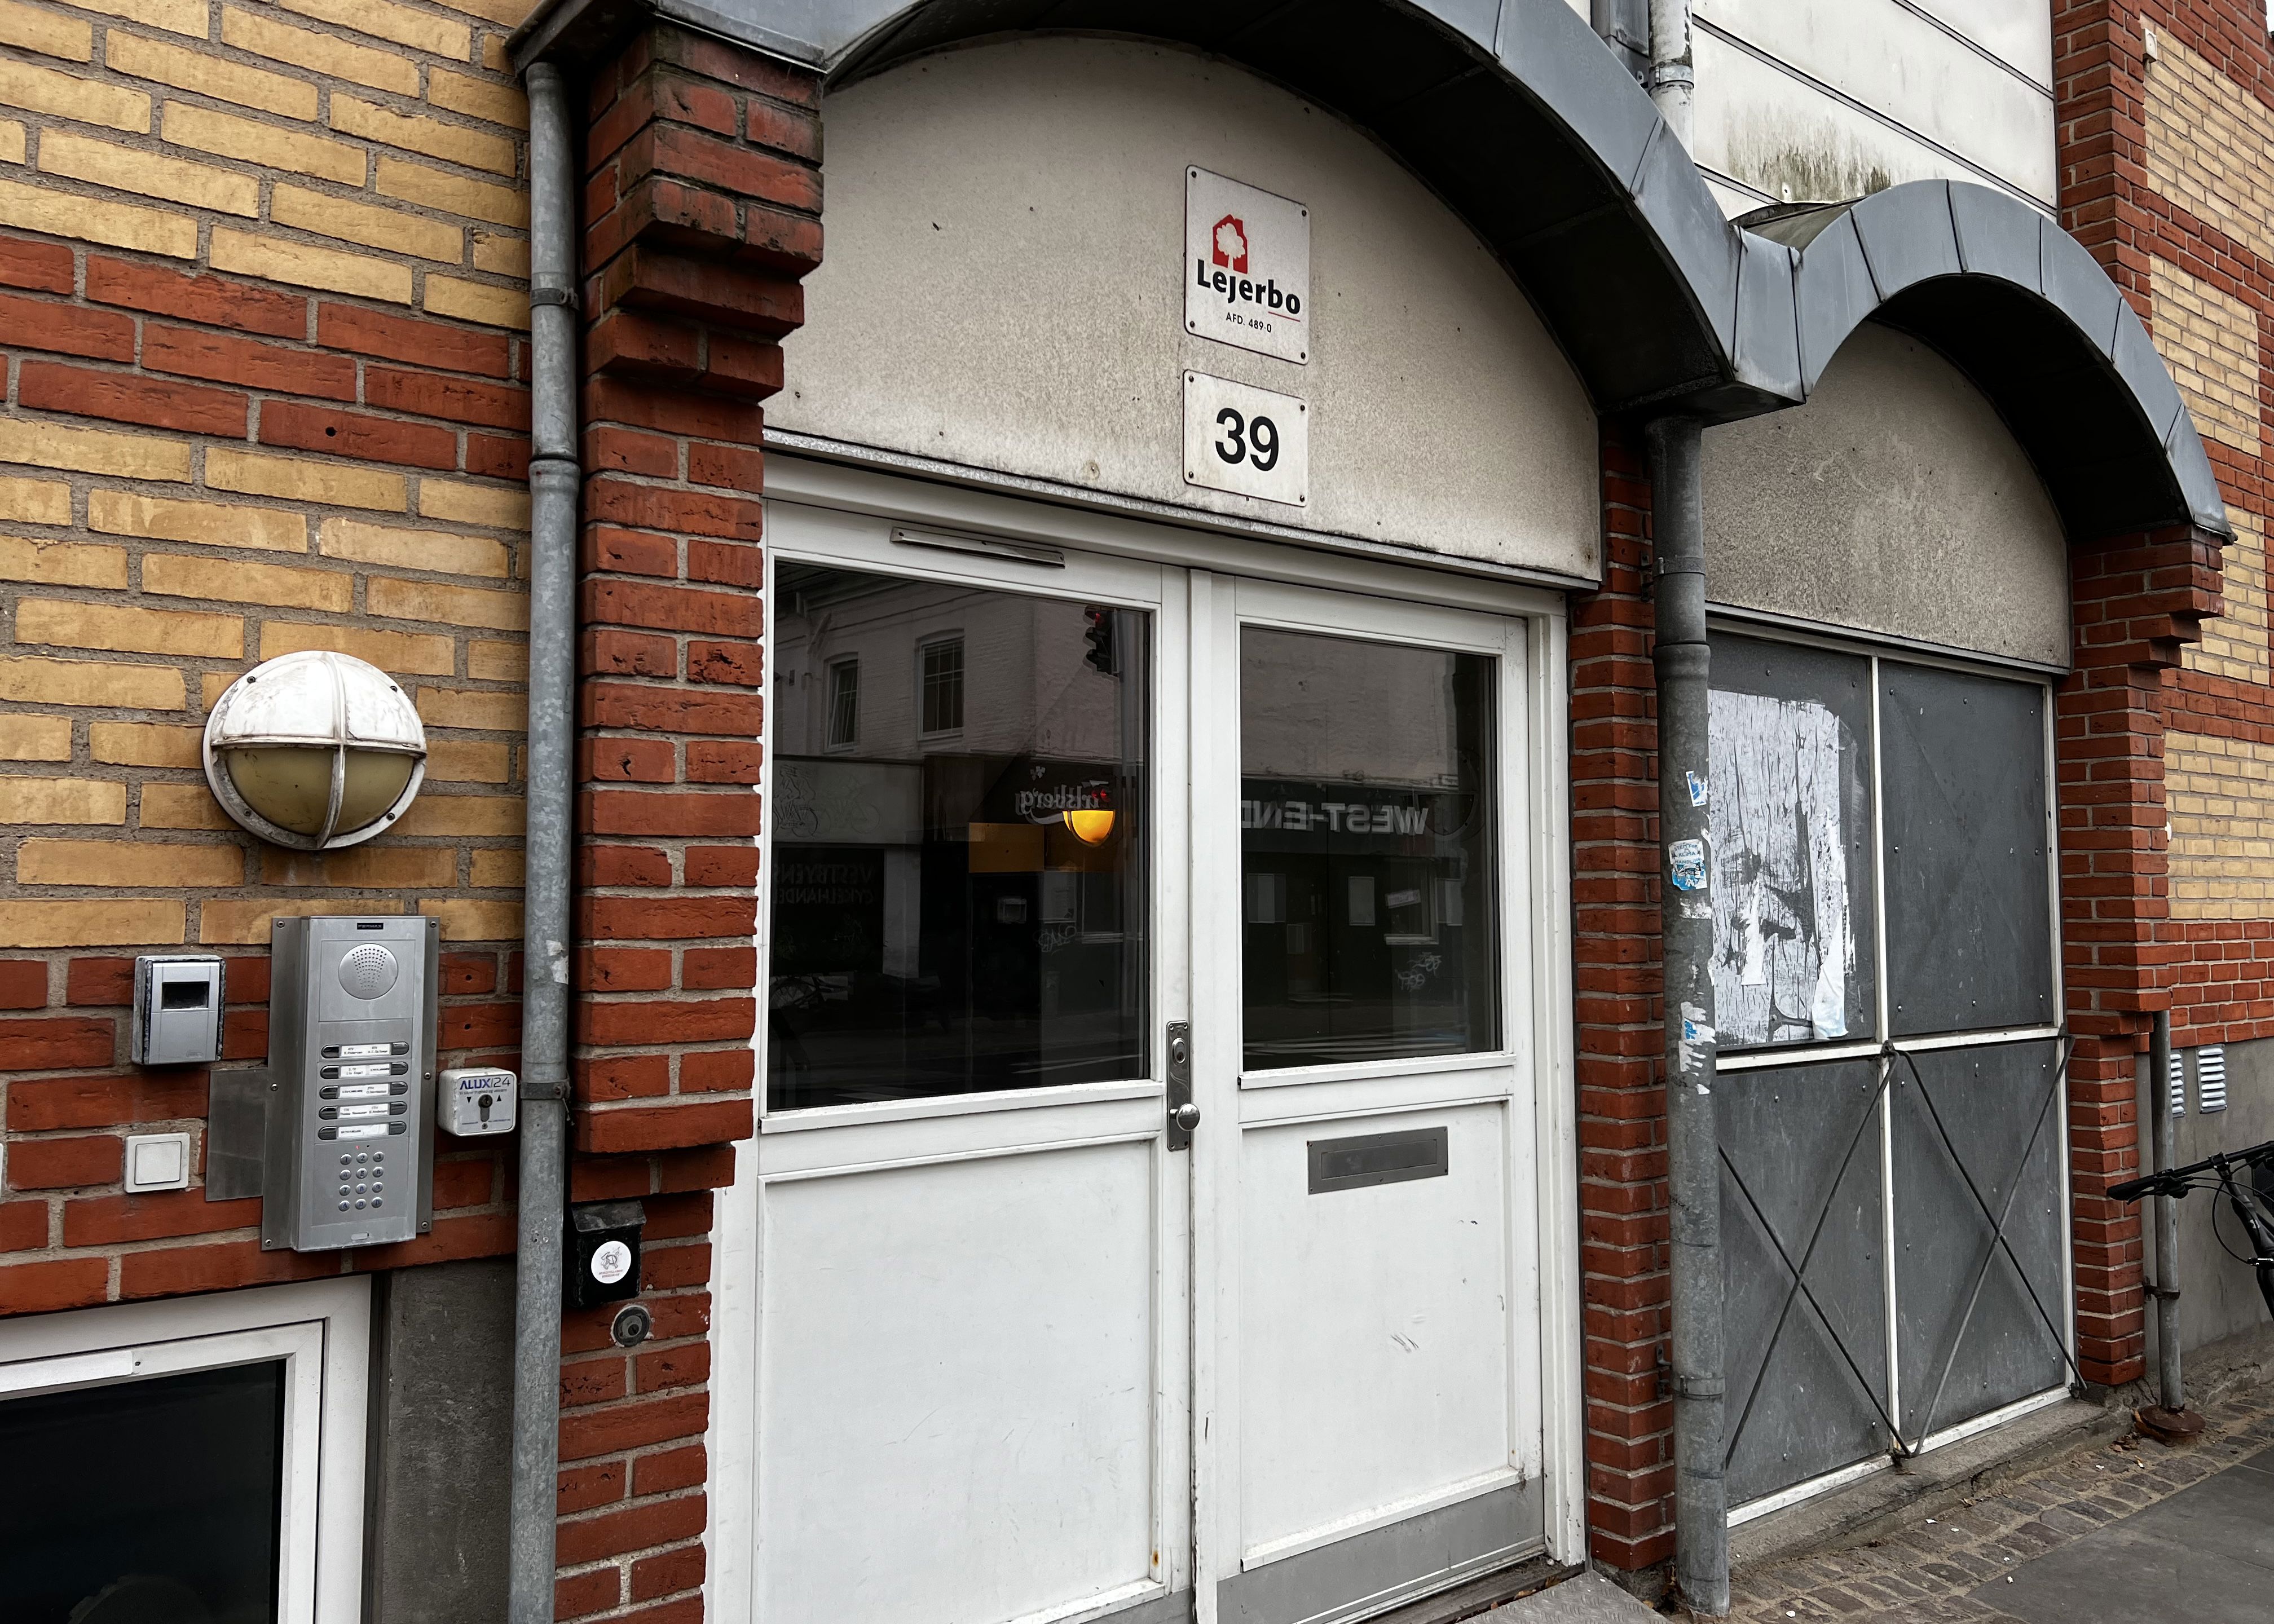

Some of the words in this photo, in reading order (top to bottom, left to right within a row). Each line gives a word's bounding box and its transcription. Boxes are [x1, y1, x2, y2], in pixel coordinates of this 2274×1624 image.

[1197, 258, 1301, 315] Lejerbo
[1226, 312, 1245, 325] AFD.
[1215, 408, 1279, 471] 39
